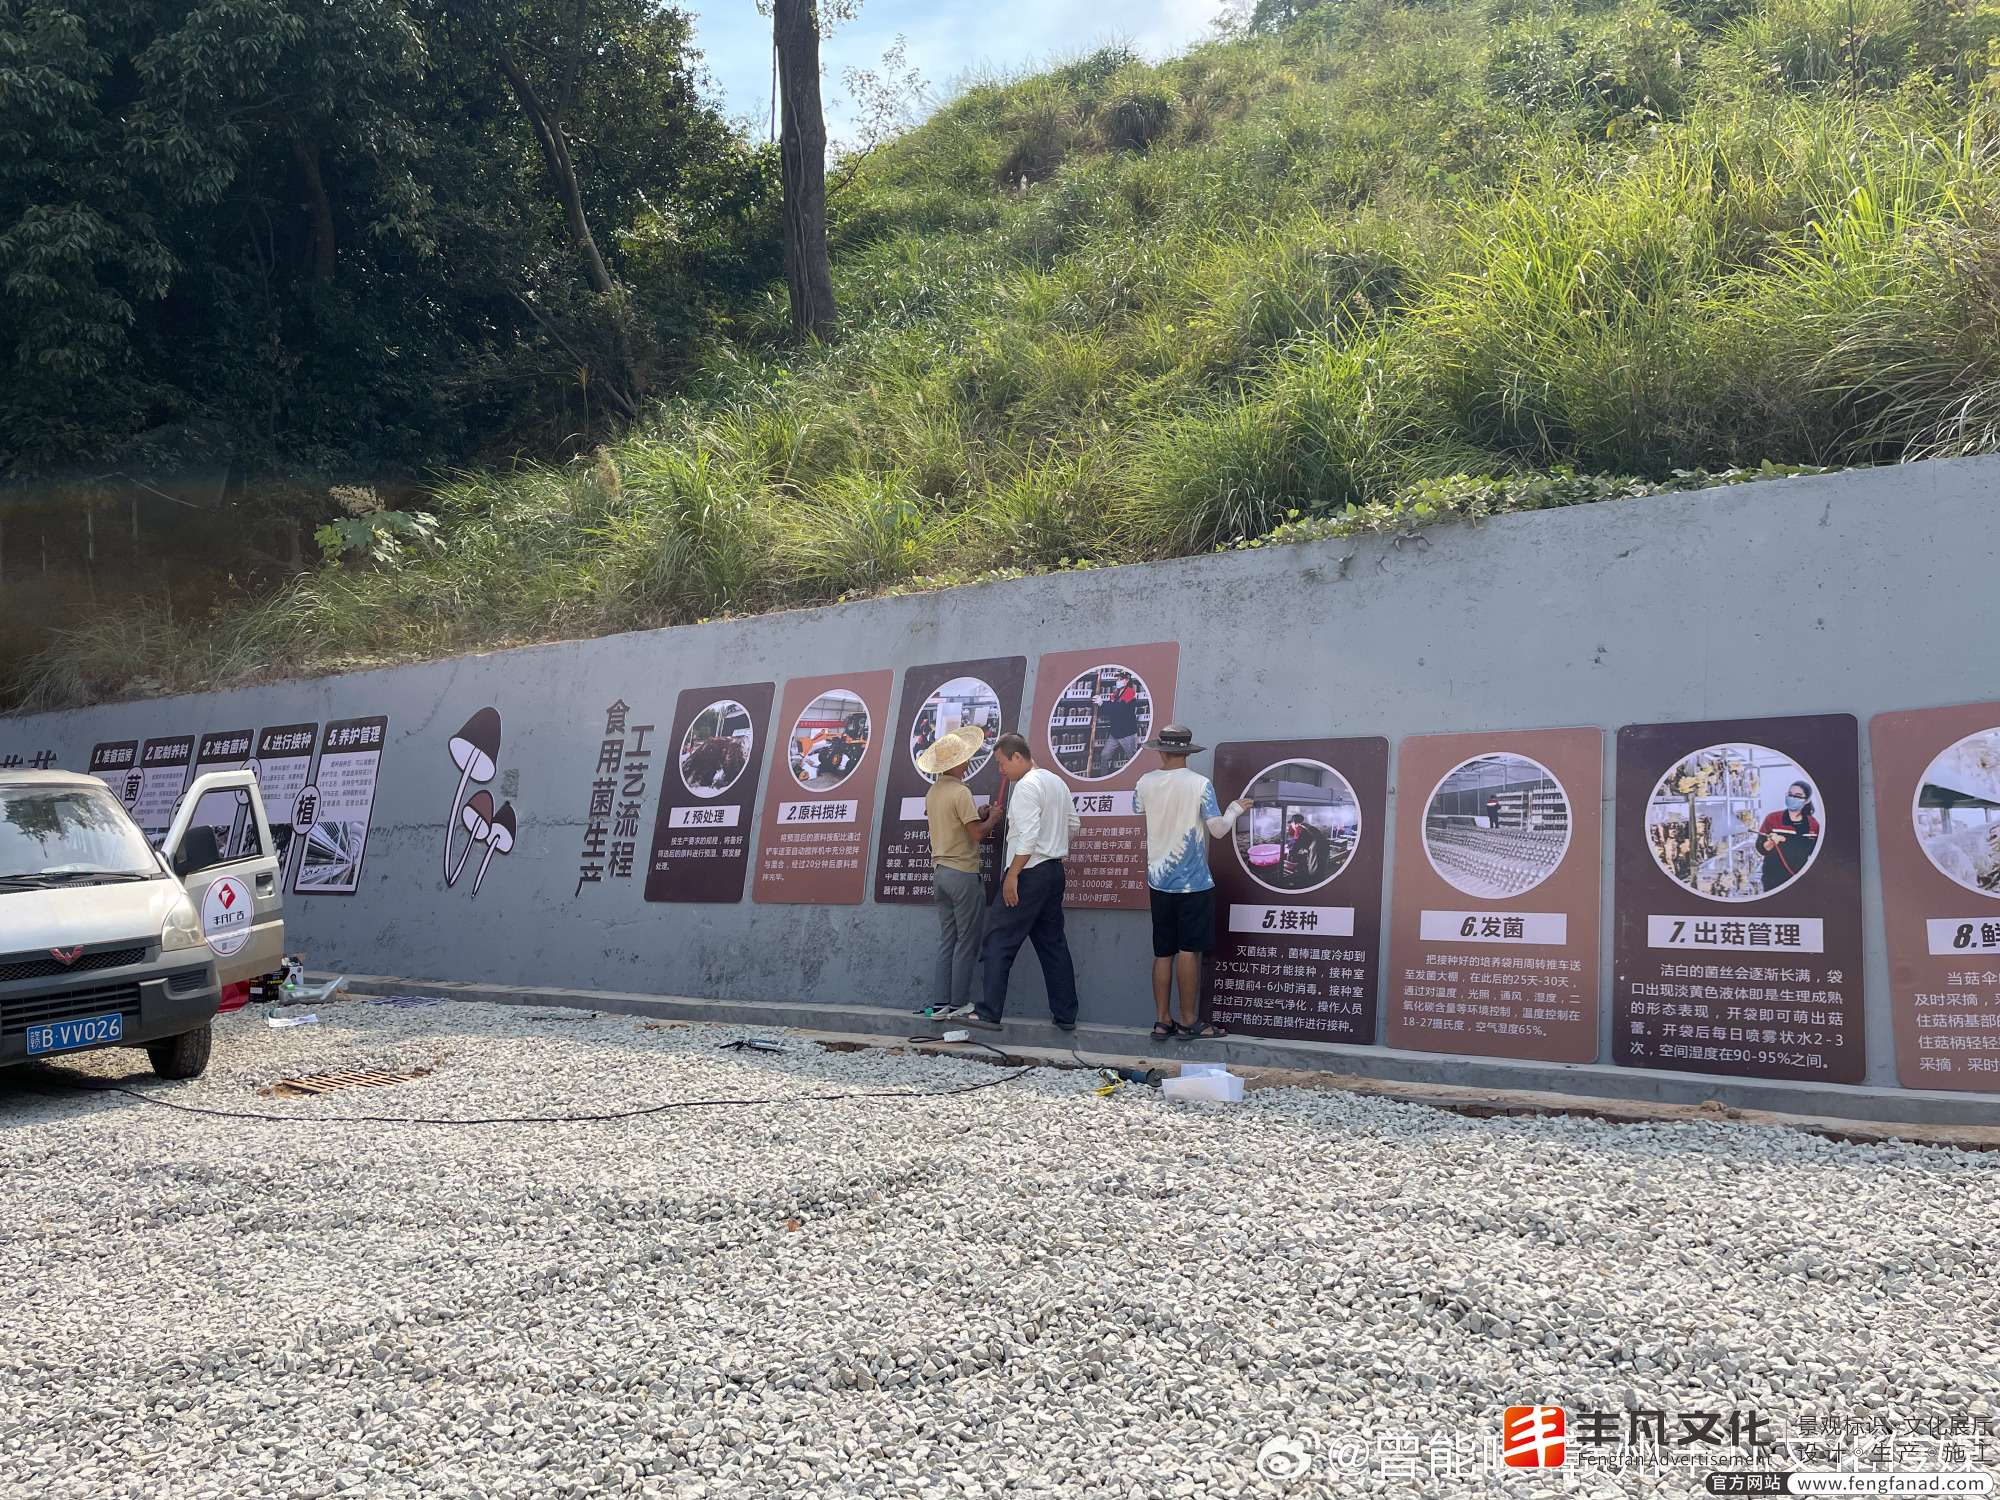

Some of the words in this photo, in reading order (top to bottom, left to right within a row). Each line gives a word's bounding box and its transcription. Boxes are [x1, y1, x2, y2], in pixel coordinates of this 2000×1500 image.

[574, 698, 631, 898] 食用菌生产
[607, 723, 655, 879] 工艺流程
[296, 794, 316, 826] 植
[682, 809, 725, 825] 1.预处理
[786, 804, 848, 820] 2.原料搅拌
[1261, 909, 1318, 932] 5.接种
[1459, 915, 1525, 940] 6.发菌
[1667, 921, 1802, 948] 7.出菇管理
[1947, 970, 2000, 987] 当菇伞
[1916, 1013, 2000, 1029] 住菇柄基部
[1918, 1035, 2000, 1050] 住菇柄轻轻
